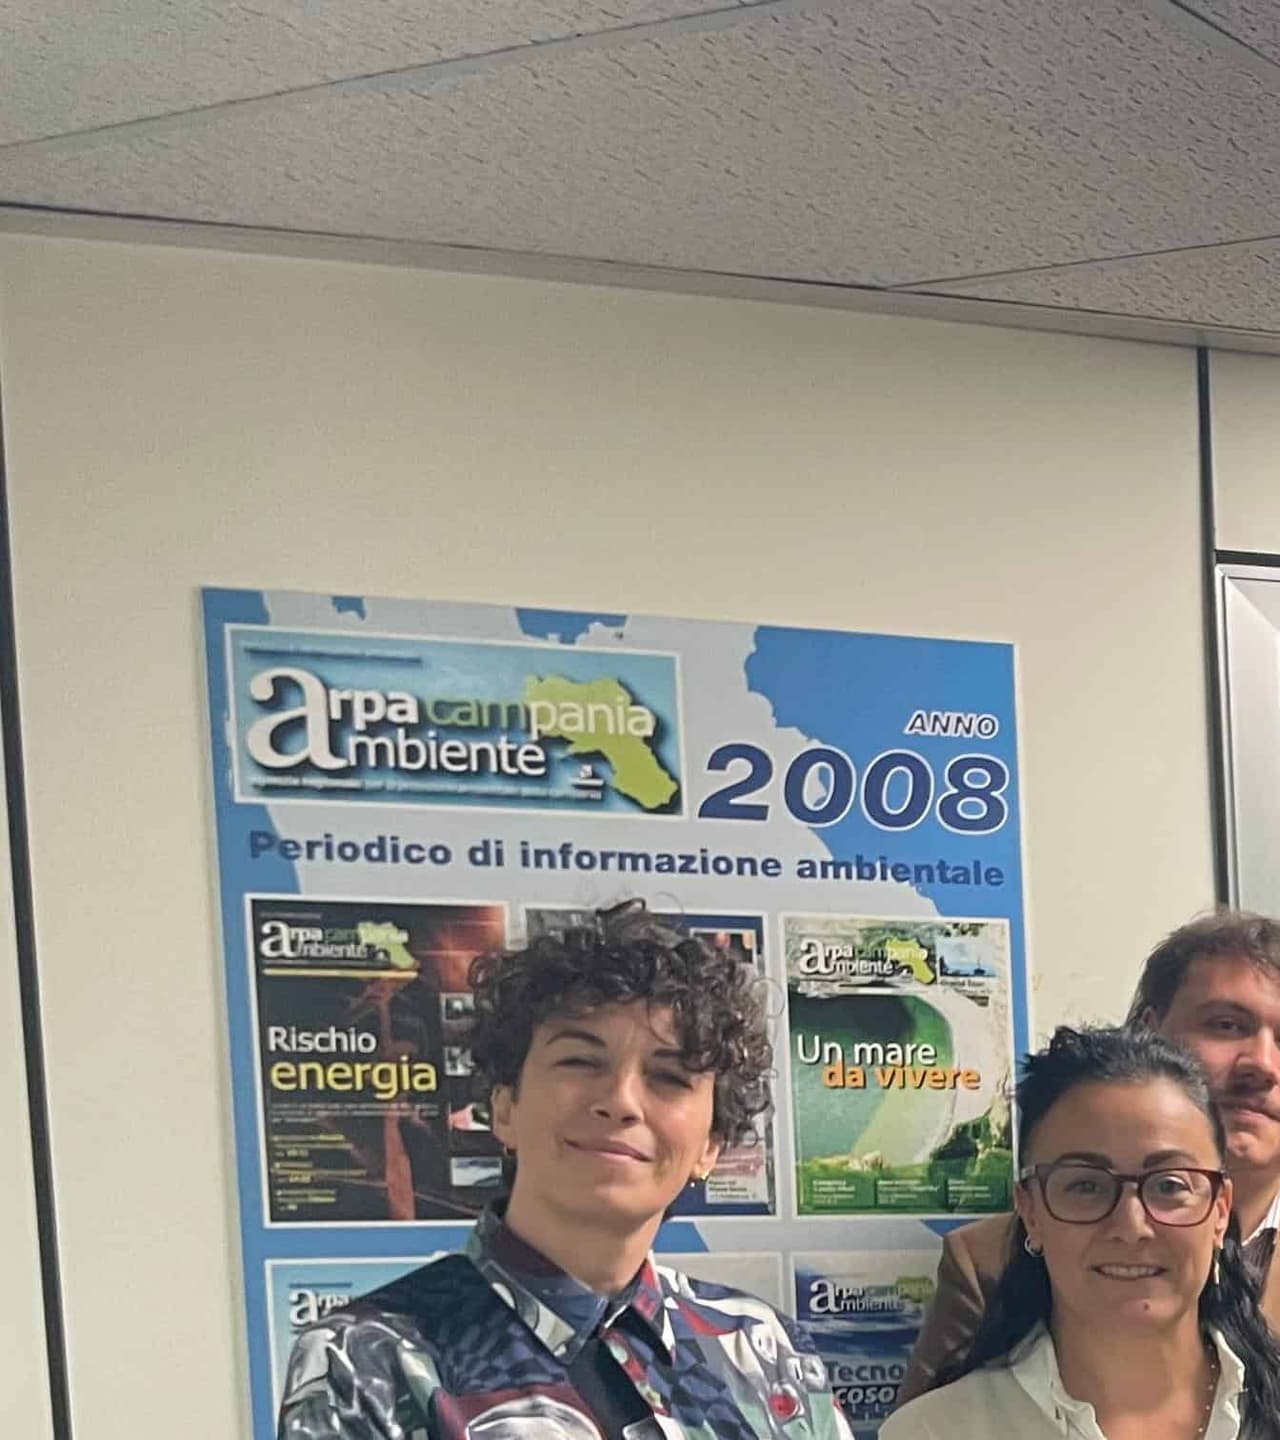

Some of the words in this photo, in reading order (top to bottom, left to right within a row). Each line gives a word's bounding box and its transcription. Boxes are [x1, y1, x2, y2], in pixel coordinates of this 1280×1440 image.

[426, 696, 657, 740] campania
[904, 709, 1000, 740] ANNO
[697, 742, 1010, 836] 2008
[249, 830, 452, 867] Periodico
[468, 839, 505, 867] di
[520, 841, 782, 878] informazione
[796, 853, 1005, 887] ambientale
[268, 1025, 377, 1053] Rischio
[797, 1034, 843, 1066] Un
[854, 1041, 938, 1067] mare
[270, 1055, 438, 1100] energia
[822, 1060, 867, 1090] da
[875, 1063, 982, 1091] vivere
